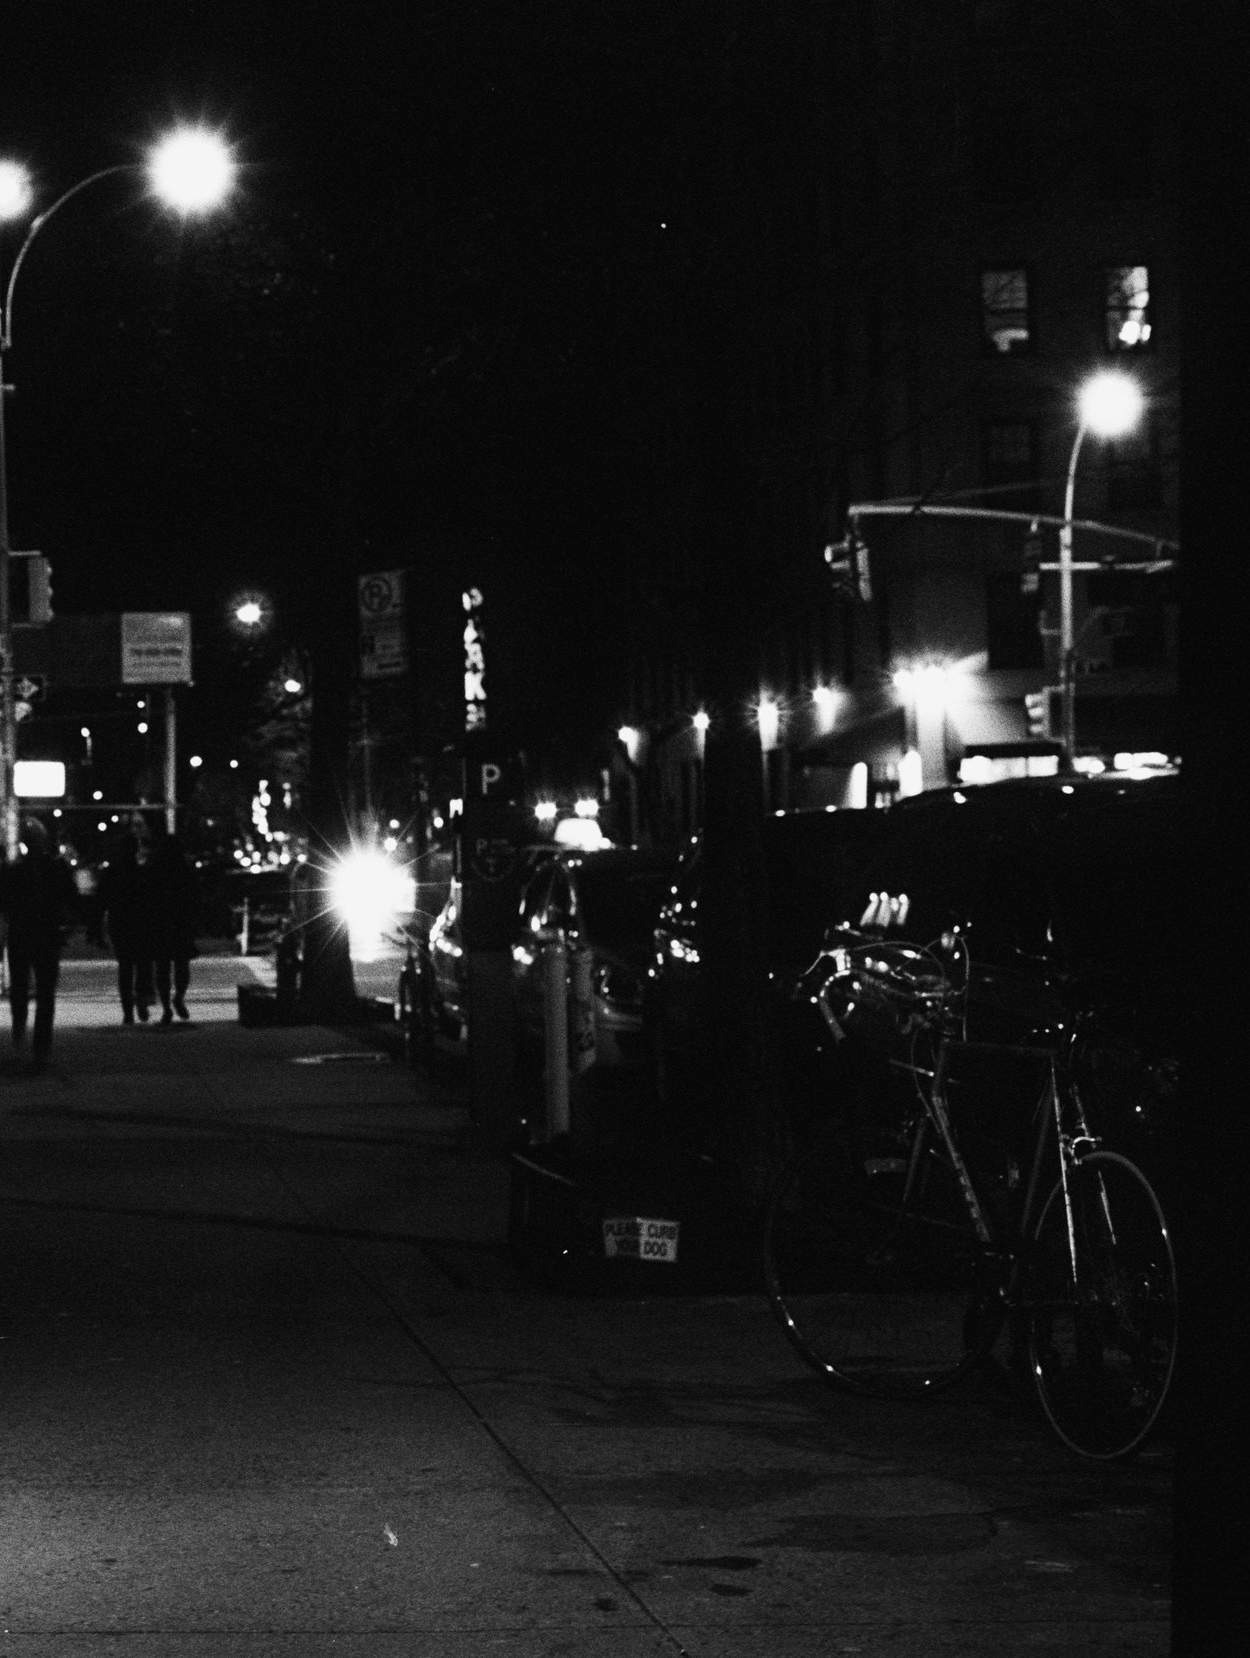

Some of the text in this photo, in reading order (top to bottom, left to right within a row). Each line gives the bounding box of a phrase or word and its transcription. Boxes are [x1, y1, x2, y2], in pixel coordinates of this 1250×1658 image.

[481, 763, 502, 795] P
[647, 1223, 678, 1240] CURB
[643, 1240, 668, 1257] DOG
